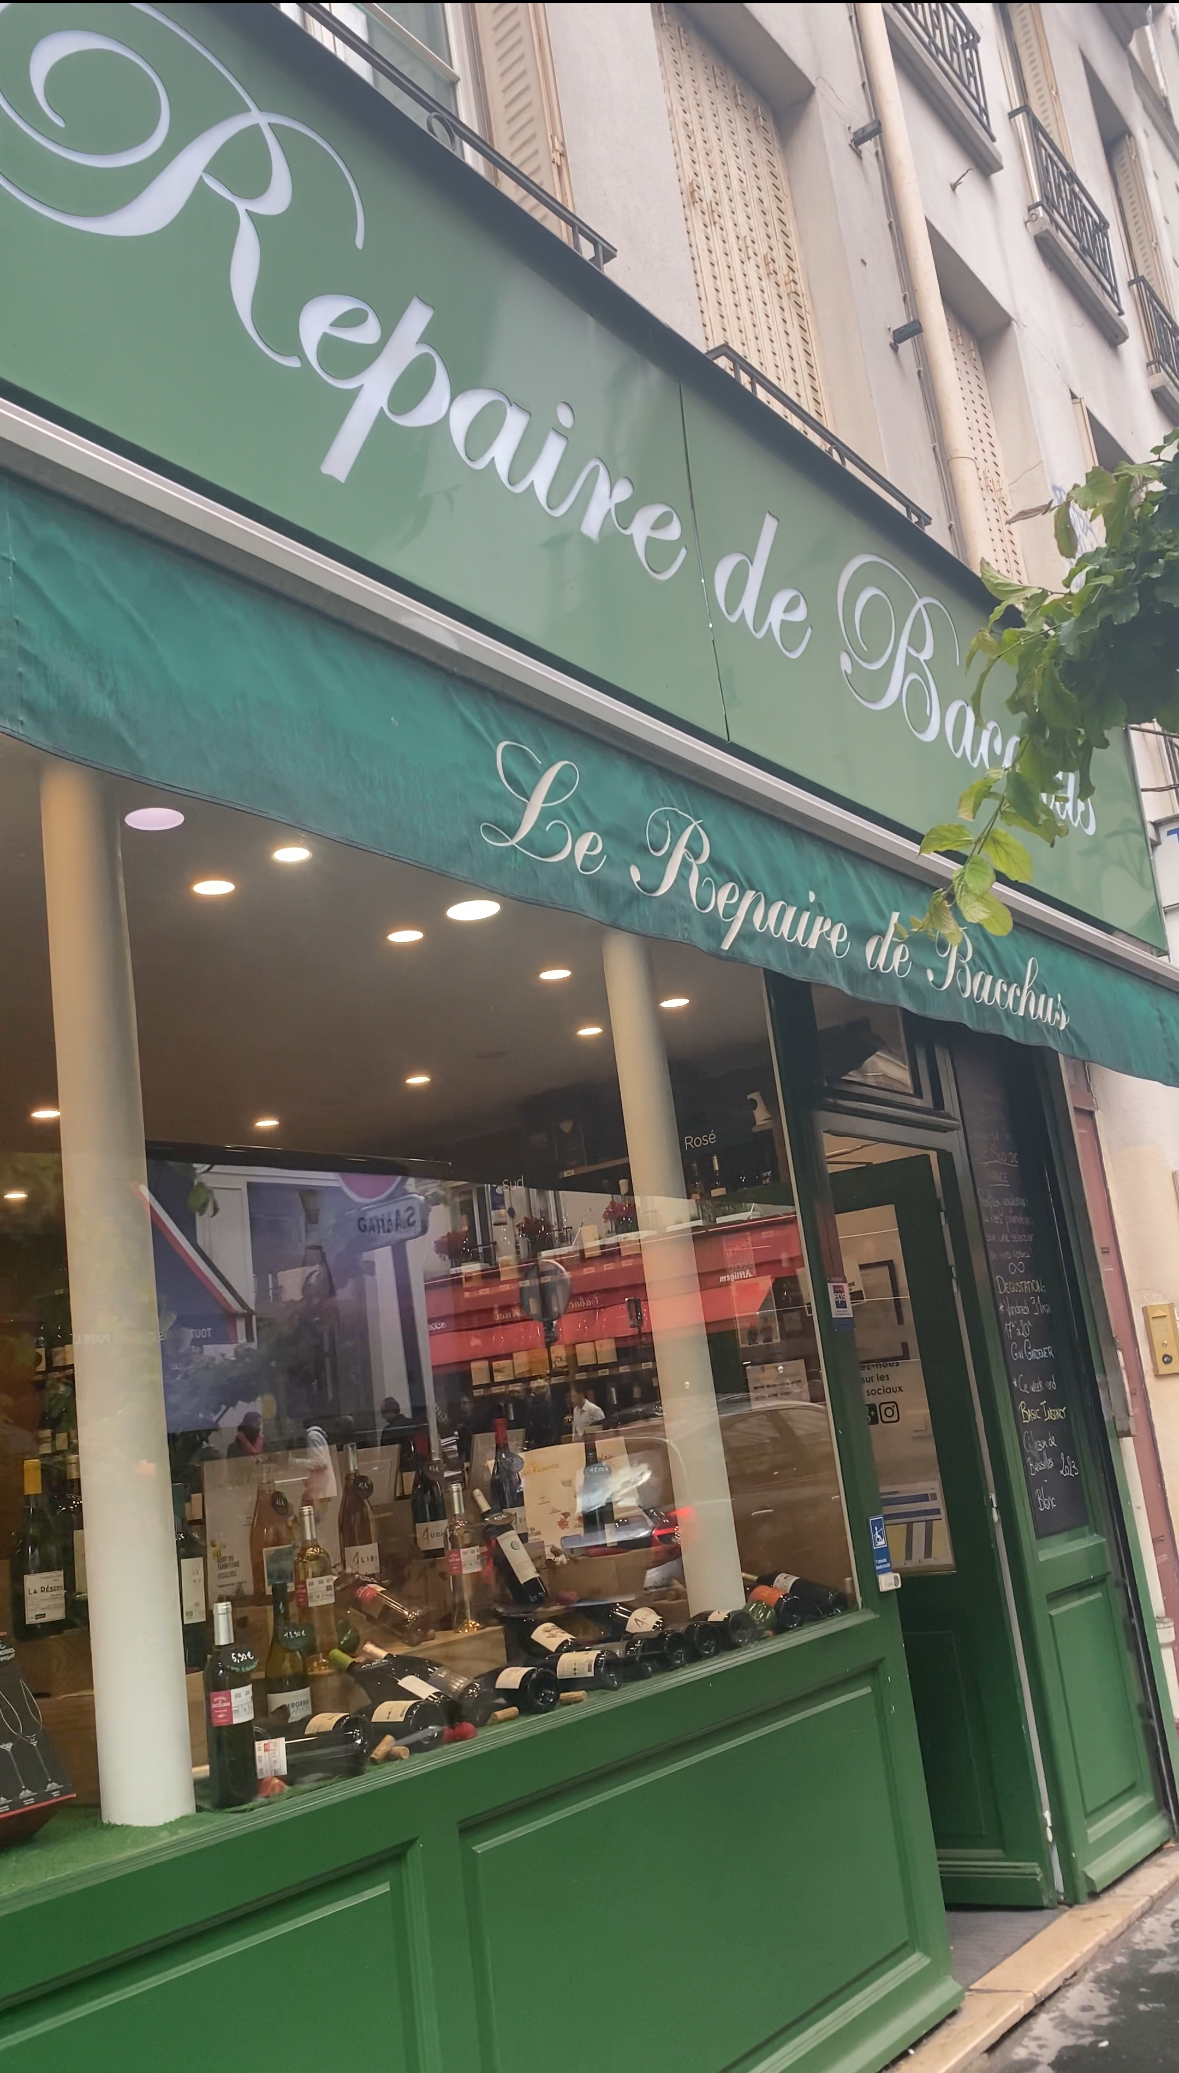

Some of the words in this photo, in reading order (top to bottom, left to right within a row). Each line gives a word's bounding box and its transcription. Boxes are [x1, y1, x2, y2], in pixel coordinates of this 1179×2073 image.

[0, 2, 688, 581] Repaire
[714, 510, 813, 660] de
[480, 740, 607, 875] Le
[629, 807, 851, 959] Repaire
[865, 911, 912, 978] de
[926, 925, 1070, 1031] Bacchus
[684, 1129, 717, 1150] Rosé
[502, 1175, 524, 1191] Sud
[876, 1373, 890, 1382] les
[866, 1385, 904, 1397] sociaux
[1060, 1452, 1079, 1477] 2023
[1035, 1486, 1057, 1511] Blanc
